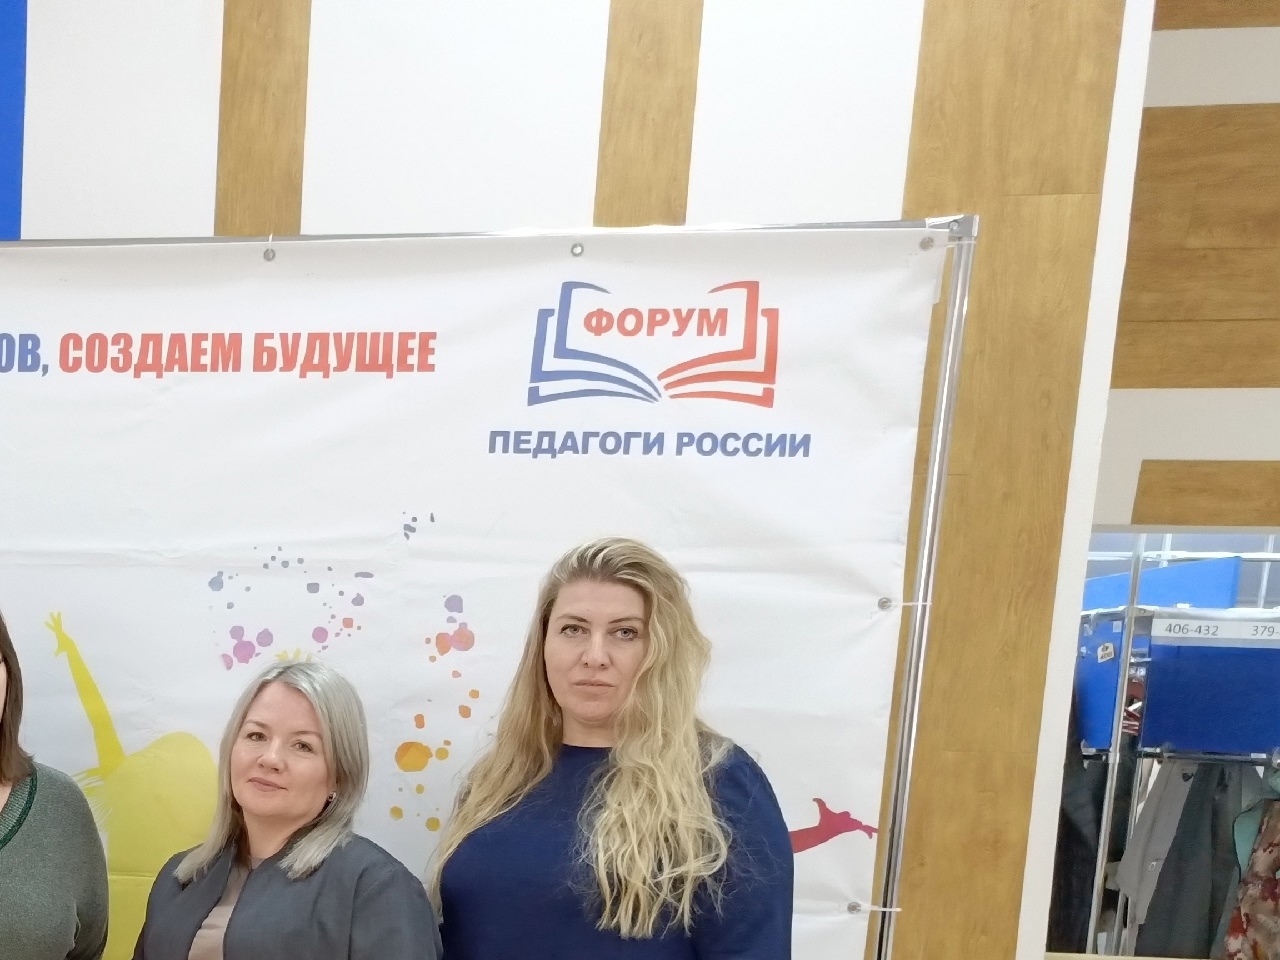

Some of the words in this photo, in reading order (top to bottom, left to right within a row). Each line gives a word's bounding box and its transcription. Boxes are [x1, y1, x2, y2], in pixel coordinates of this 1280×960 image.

[583, 308, 728, 337] ФОРУМ
[59, 333, 243, 379] СОЗДАЕМ
[253, 332, 437, 379] БУДУЩЕЕ
[488, 431, 665, 459] ПЕДАГОГИ
[675, 432, 812, 458] РОССИИ
[1164, 623, 1219, 636] 406-432
[1251, 625, 1280, 637] 379-
